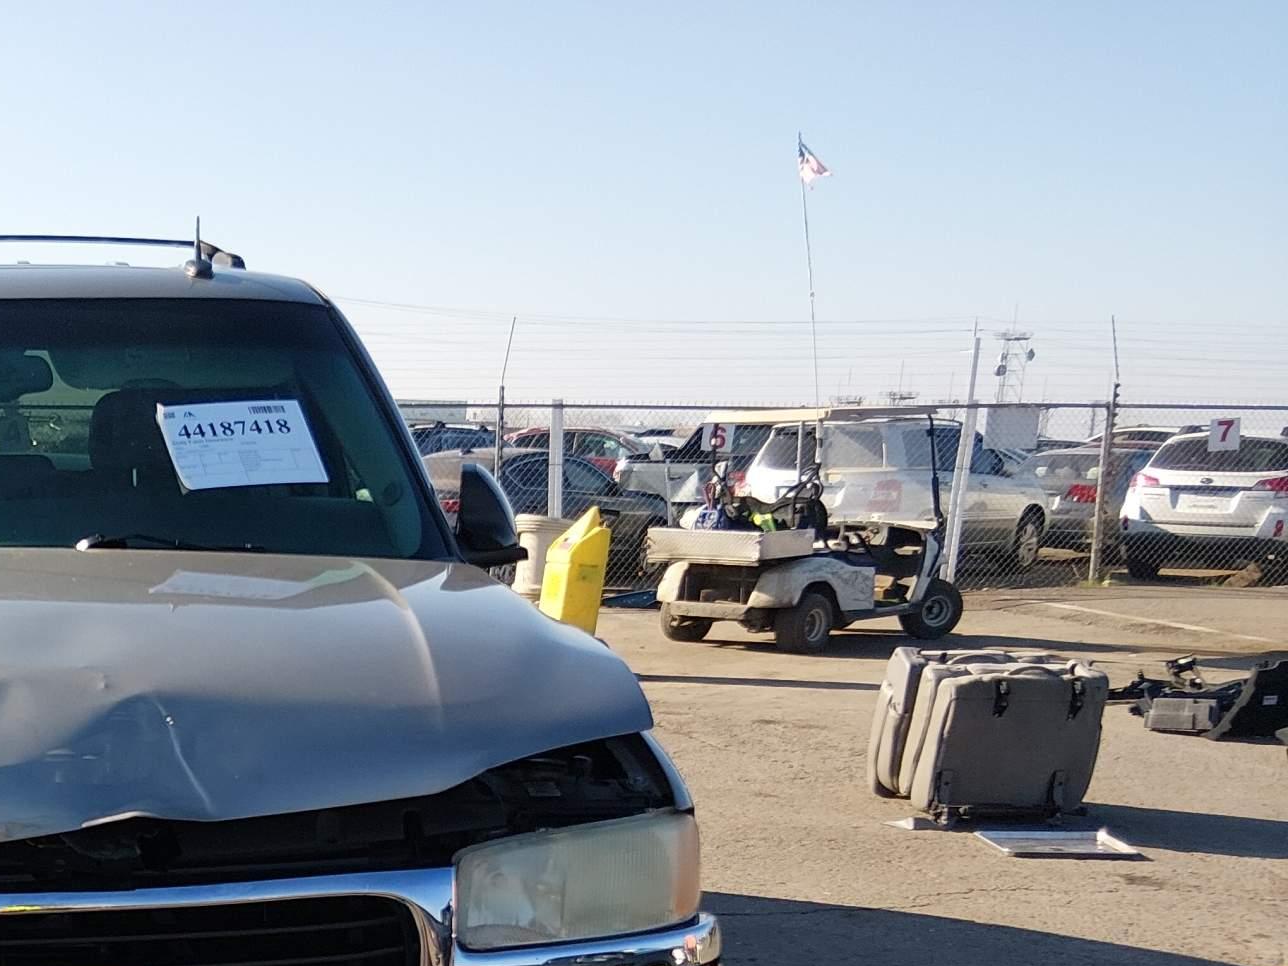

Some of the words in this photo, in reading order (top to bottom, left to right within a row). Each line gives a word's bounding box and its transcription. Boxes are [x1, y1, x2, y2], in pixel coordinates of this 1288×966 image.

[178, 418, 291, 439] 44187418
[709, 426, 726, 449] 6
[1217, 420, 1234, 442] 7
